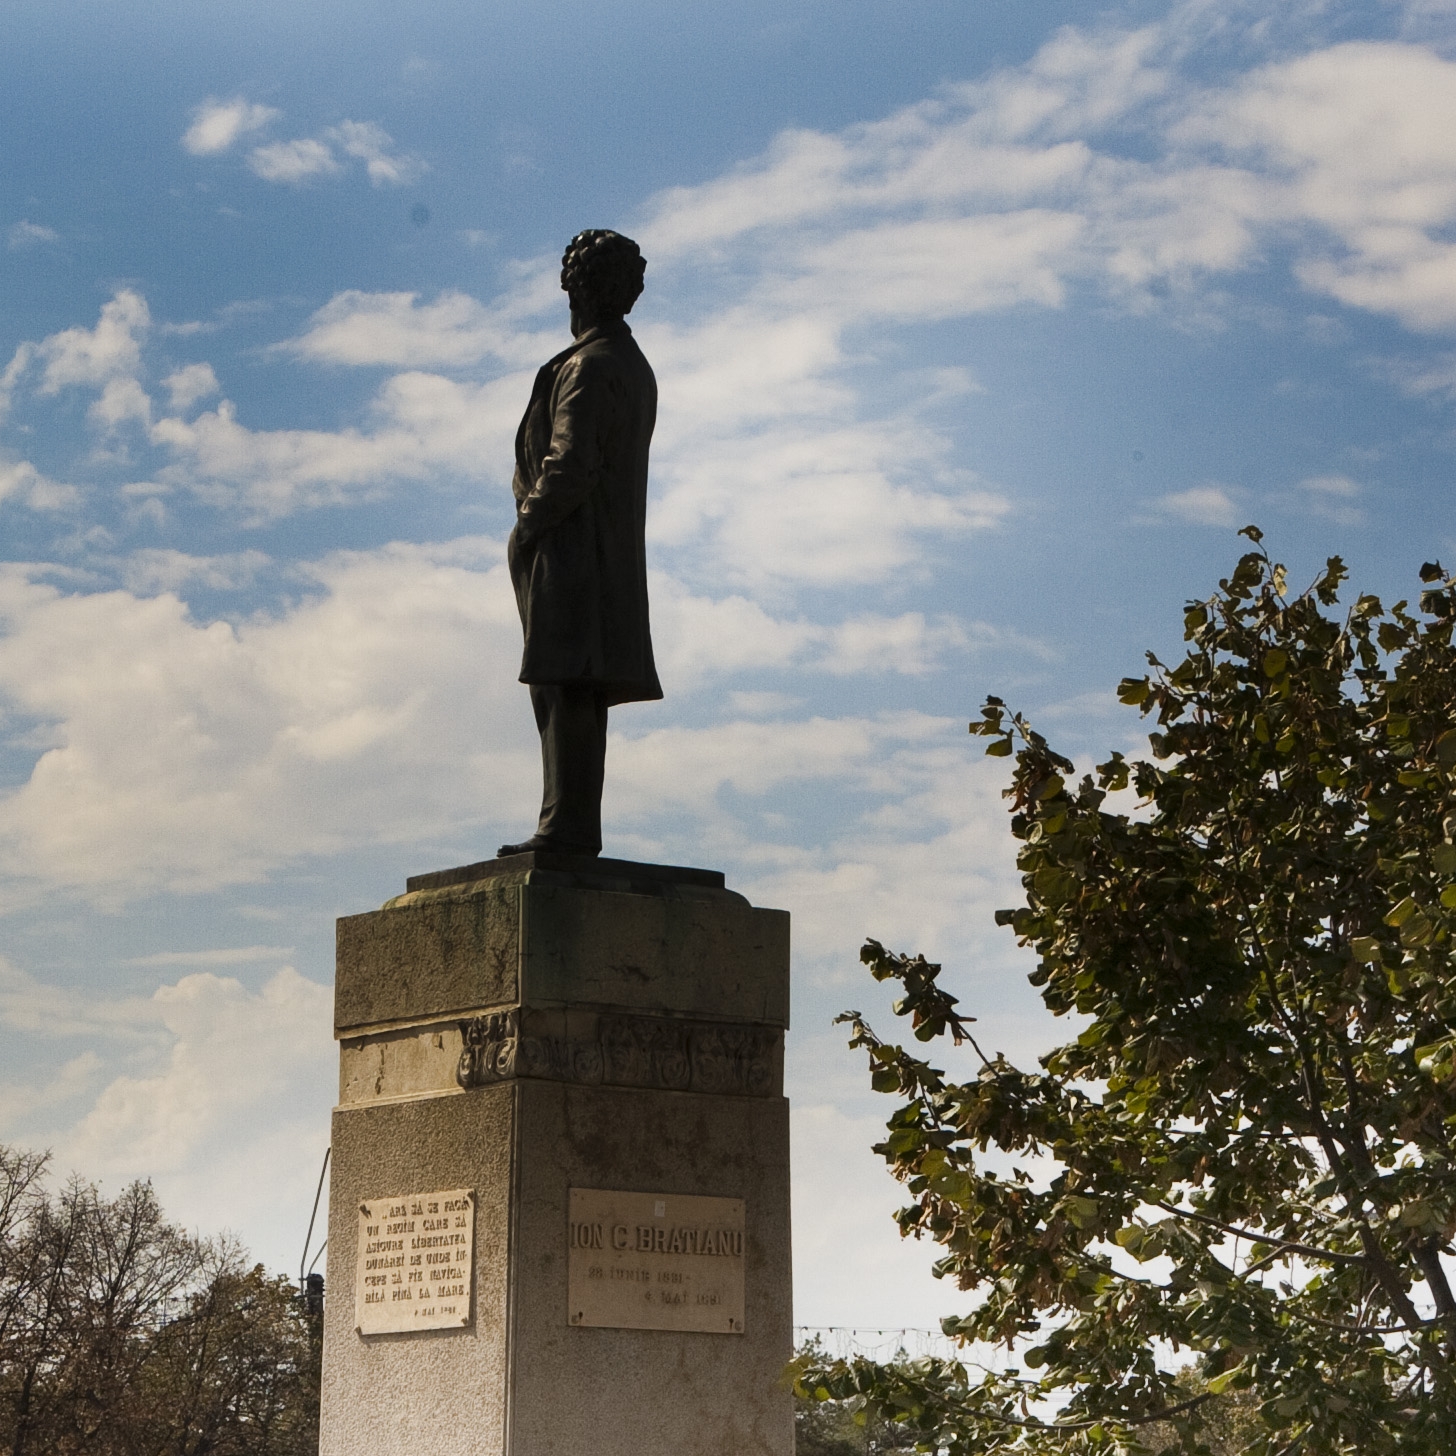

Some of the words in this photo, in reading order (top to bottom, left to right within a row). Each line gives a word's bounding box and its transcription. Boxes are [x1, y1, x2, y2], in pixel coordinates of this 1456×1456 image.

[367, 1226, 379, 1236] UN
[423, 1219, 448, 1231] CARE
[571, 1222, 603, 1250] ION
[636, 1226, 744, 1257] BRATIANU
[410, 1255, 421, 1265] DE
[427, 1252, 450, 1264] UNDE
[419, 1288, 430, 1299] LA
